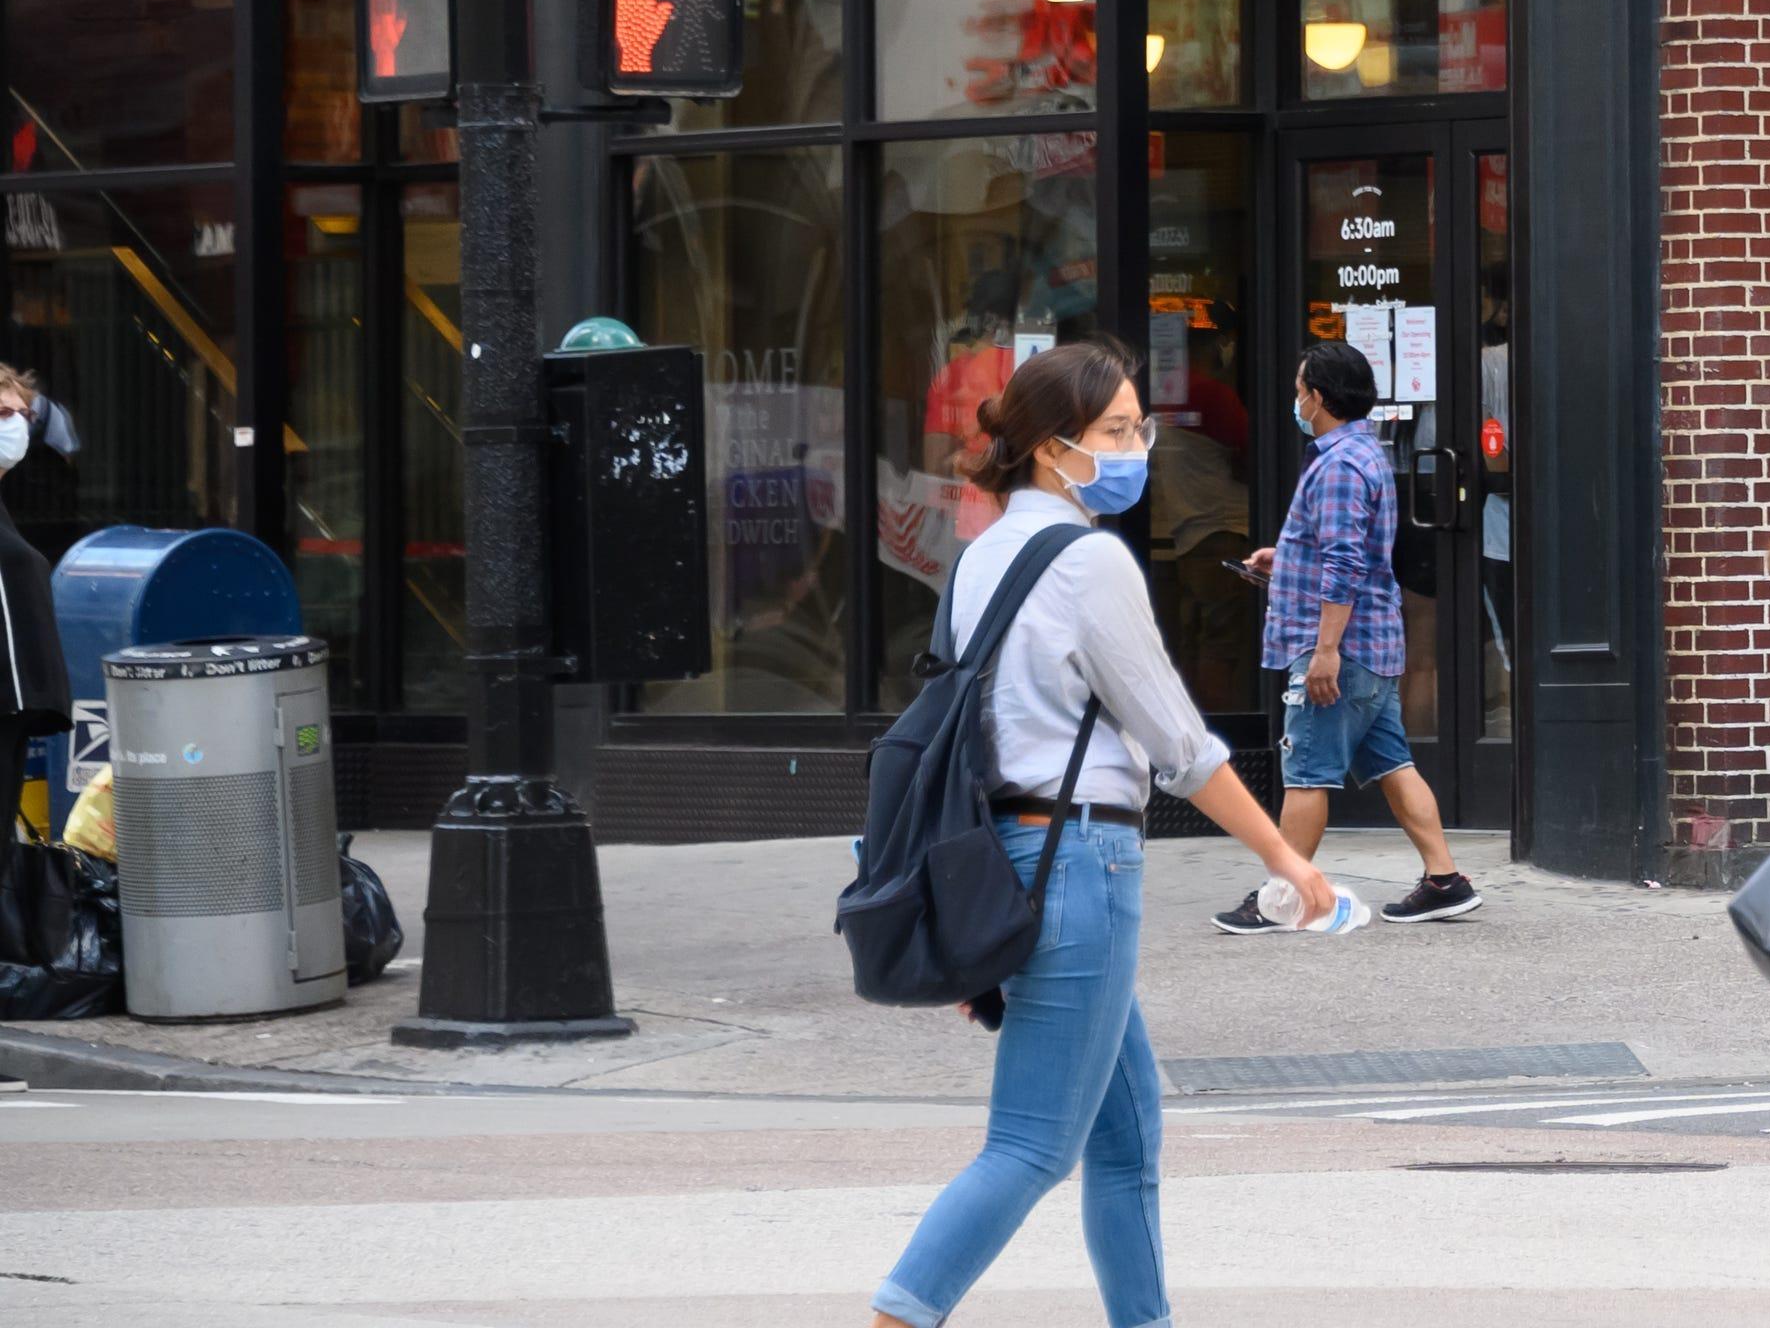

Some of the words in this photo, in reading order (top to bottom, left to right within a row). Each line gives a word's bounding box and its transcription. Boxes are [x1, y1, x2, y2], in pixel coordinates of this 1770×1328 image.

[1341, 216, 1395, 240] 6:30am
[1337, 264, 1400, 290] 10:00pm
[703, 348, 800, 395] OME
[205, 659, 244, 676] Don't
[248, 657, 282, 672] litter
